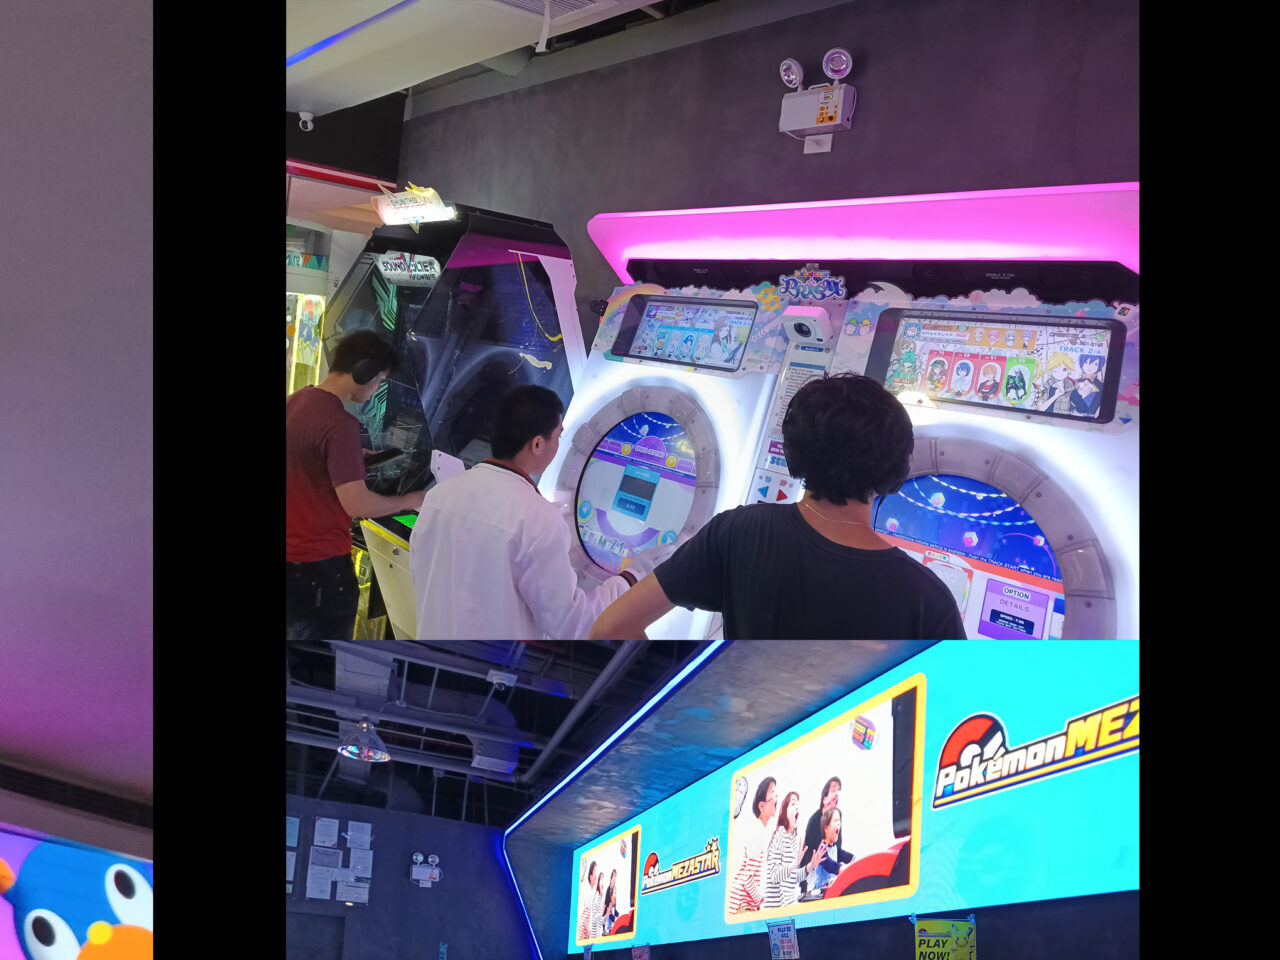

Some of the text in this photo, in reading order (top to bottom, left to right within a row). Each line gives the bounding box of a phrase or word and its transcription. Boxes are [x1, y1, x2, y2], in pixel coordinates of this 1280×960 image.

[1059, 346, 1085, 354] TRACK
[770, 456, 788, 467] SEG
[969, 553, 980, 561] Push
[988, 557, 1003, 566] TRACK
[1004, 562, 1020, 571] START
[1020, 567, 1032, 575] when
[1004, 587, 1030, 600] OPTION
[1000, 598, 1030, 612] DETAILS
[936, 735, 1066, 798] Pokémon
[672, 850, 719, 880] MEZASTAR
[918, 939, 948, 948] PLAY
[918, 951, 950, 960] NOW!
